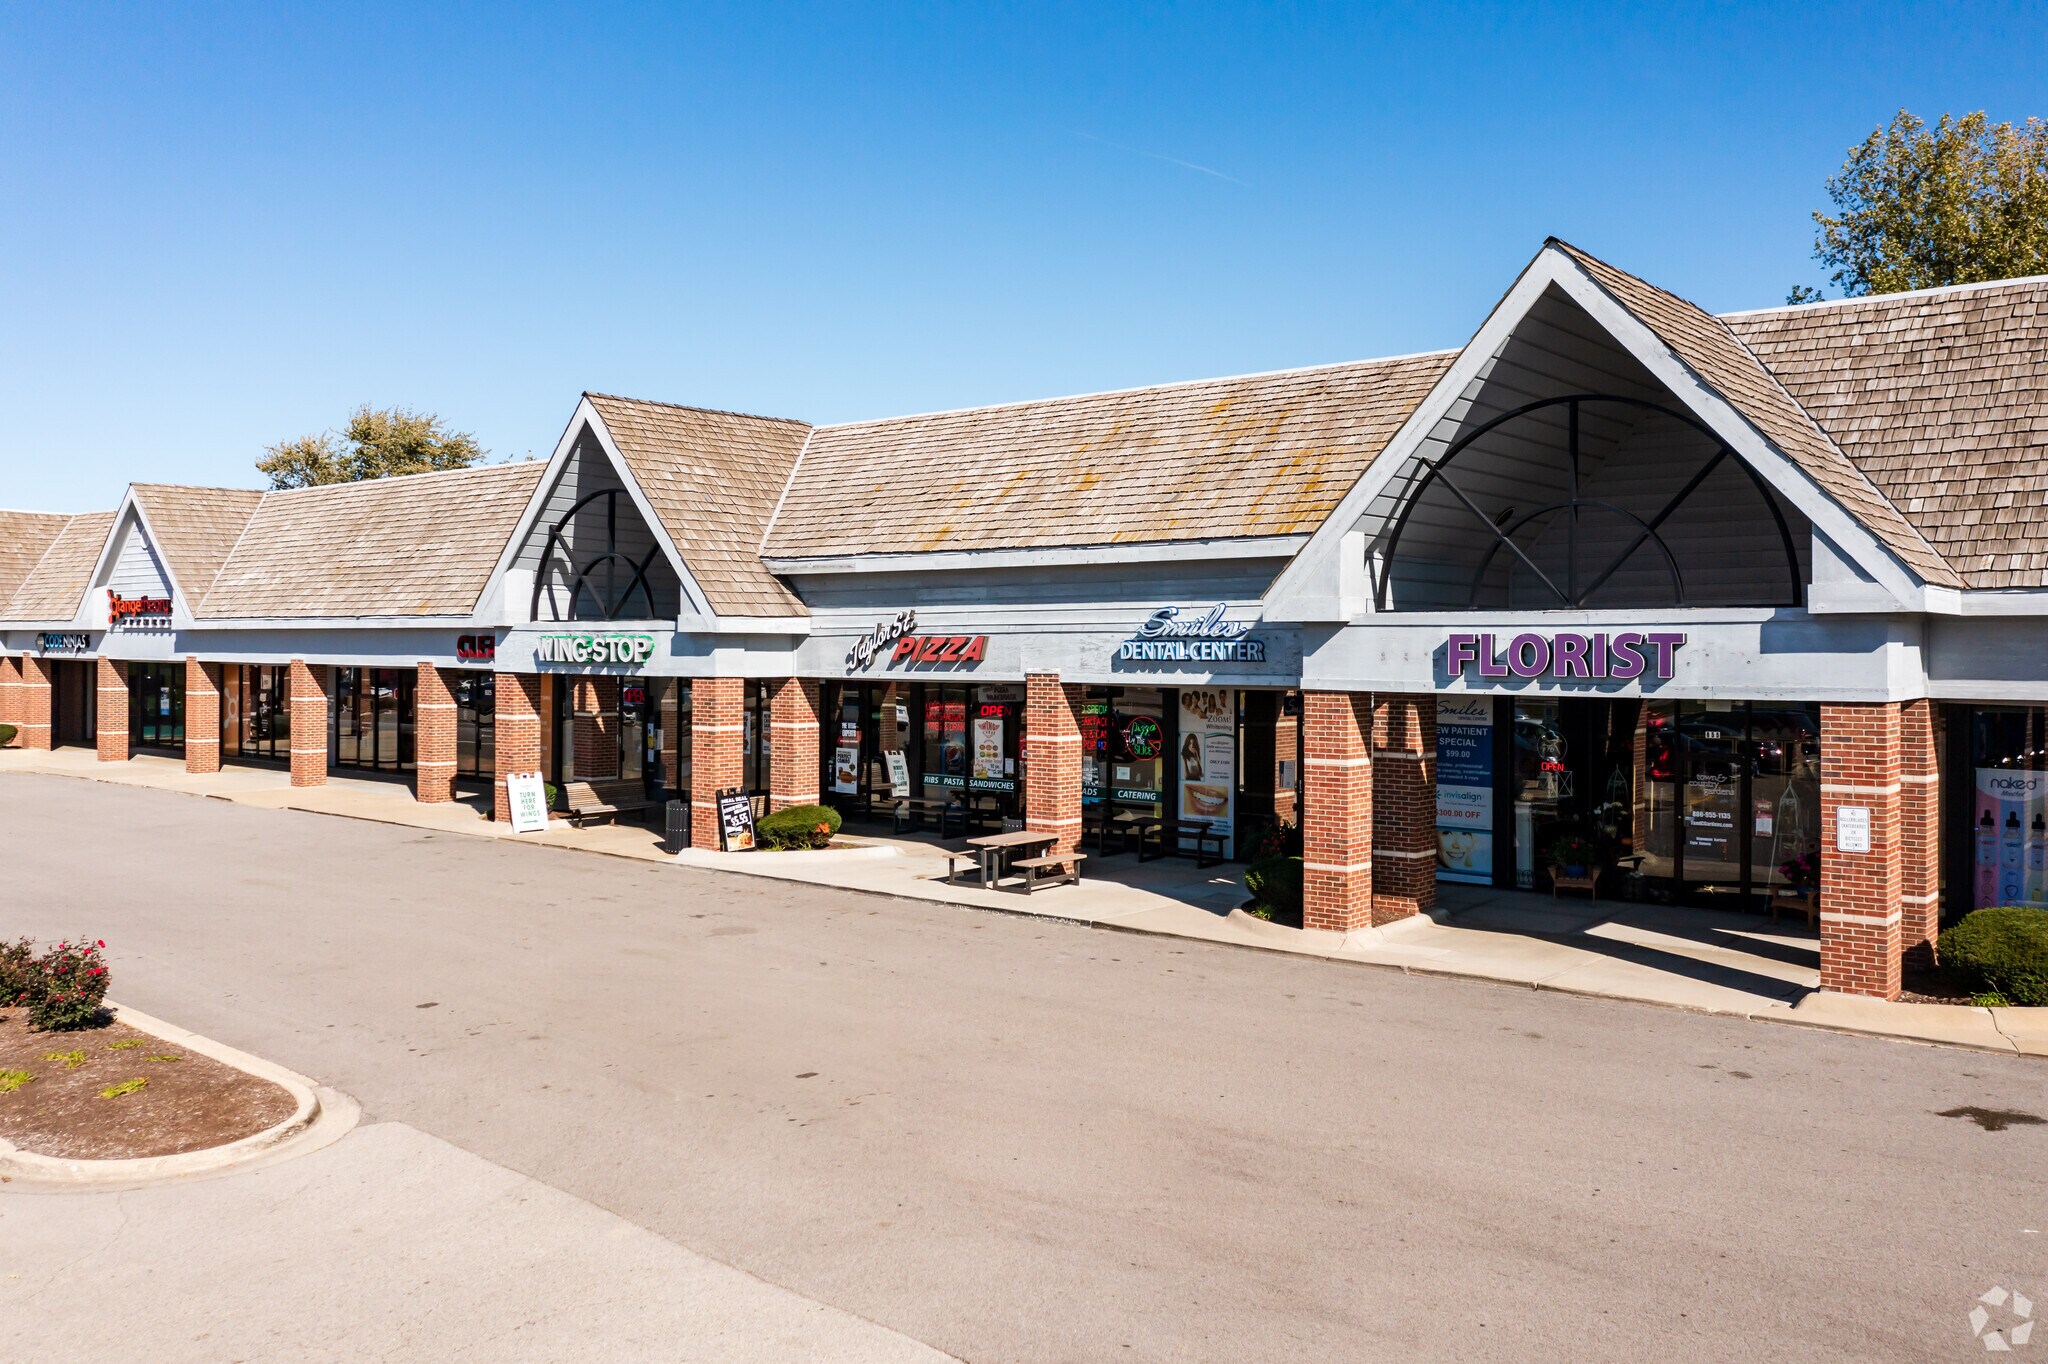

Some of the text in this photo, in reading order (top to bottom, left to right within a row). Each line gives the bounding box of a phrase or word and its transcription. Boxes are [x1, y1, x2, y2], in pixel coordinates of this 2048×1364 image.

[1136, 602, 1248, 637] Smiles
[45, 634, 87, 653] CODE NINJAS
[849, 622, 893, 669] Taylor
[891, 636, 987, 662] PIZZA
[1120, 640, 1265, 662] DENTAL CENTER
[1447, 632, 1688, 679] FLORIST
[981, 705, 1012, 716] OPEN
[1451, 727, 1488, 736] PATIENT
[1439, 737, 1477, 747] SPECIAL
[1446, 749, 1470, 758] $99.00
[1541, 761, 1564, 771] OPEN
[924, 776, 1014, 790] RIBS PASTA SANDWICHES
[1990, 777, 2036, 790] naked
[1118, 790, 1156, 801] CATERING
[1444, 790, 1482, 802] invisalign
